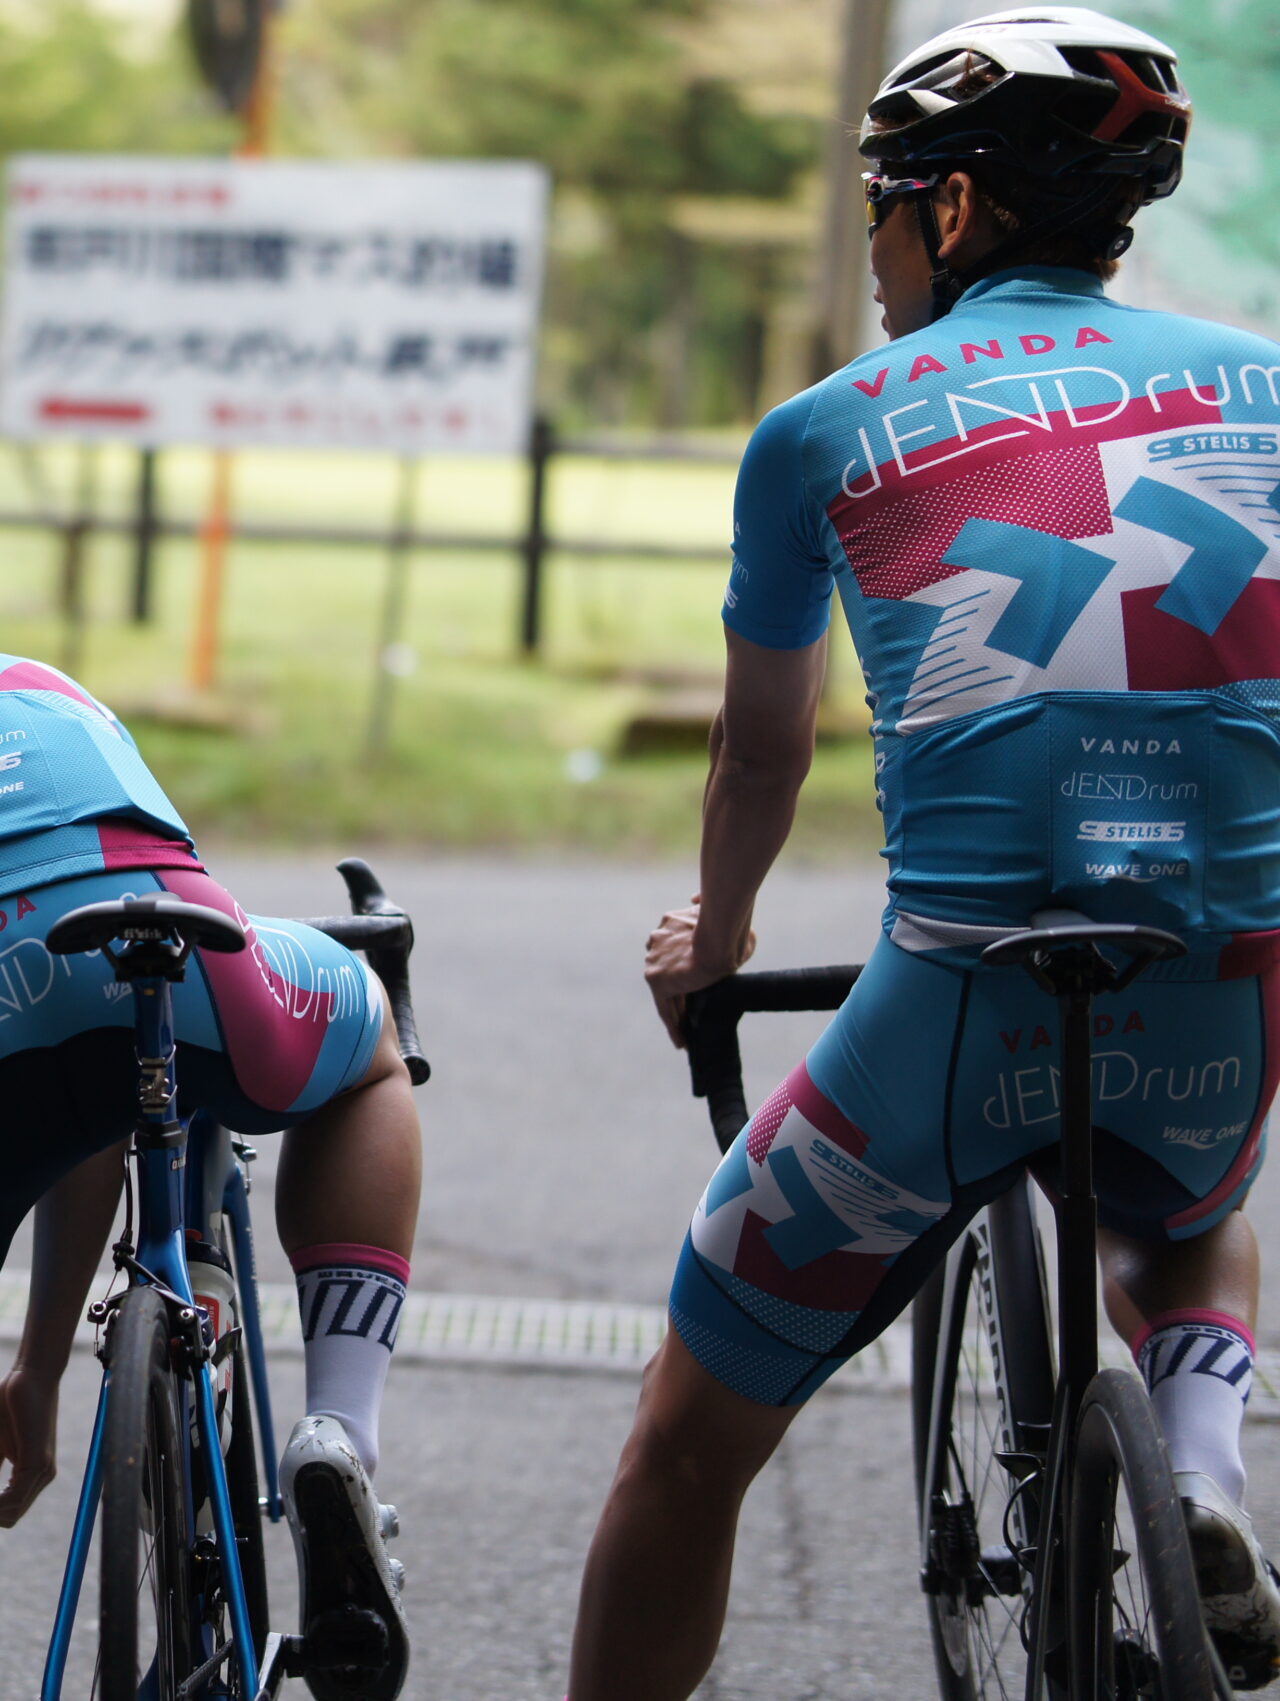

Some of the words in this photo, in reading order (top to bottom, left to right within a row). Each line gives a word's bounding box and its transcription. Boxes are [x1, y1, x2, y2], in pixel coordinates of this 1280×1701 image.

[852, 327, 1113, 399] VANDA
[1080, 737, 1182, 754] VANDA
[1085, 863, 1141, 876] WAVE
[1149, 863, 1188, 876] ONE
[999, 1010, 1145, 1053] VADA
[1162, 1126, 1211, 1143] WAVE
[1216, 1120, 1248, 1140] ONE
